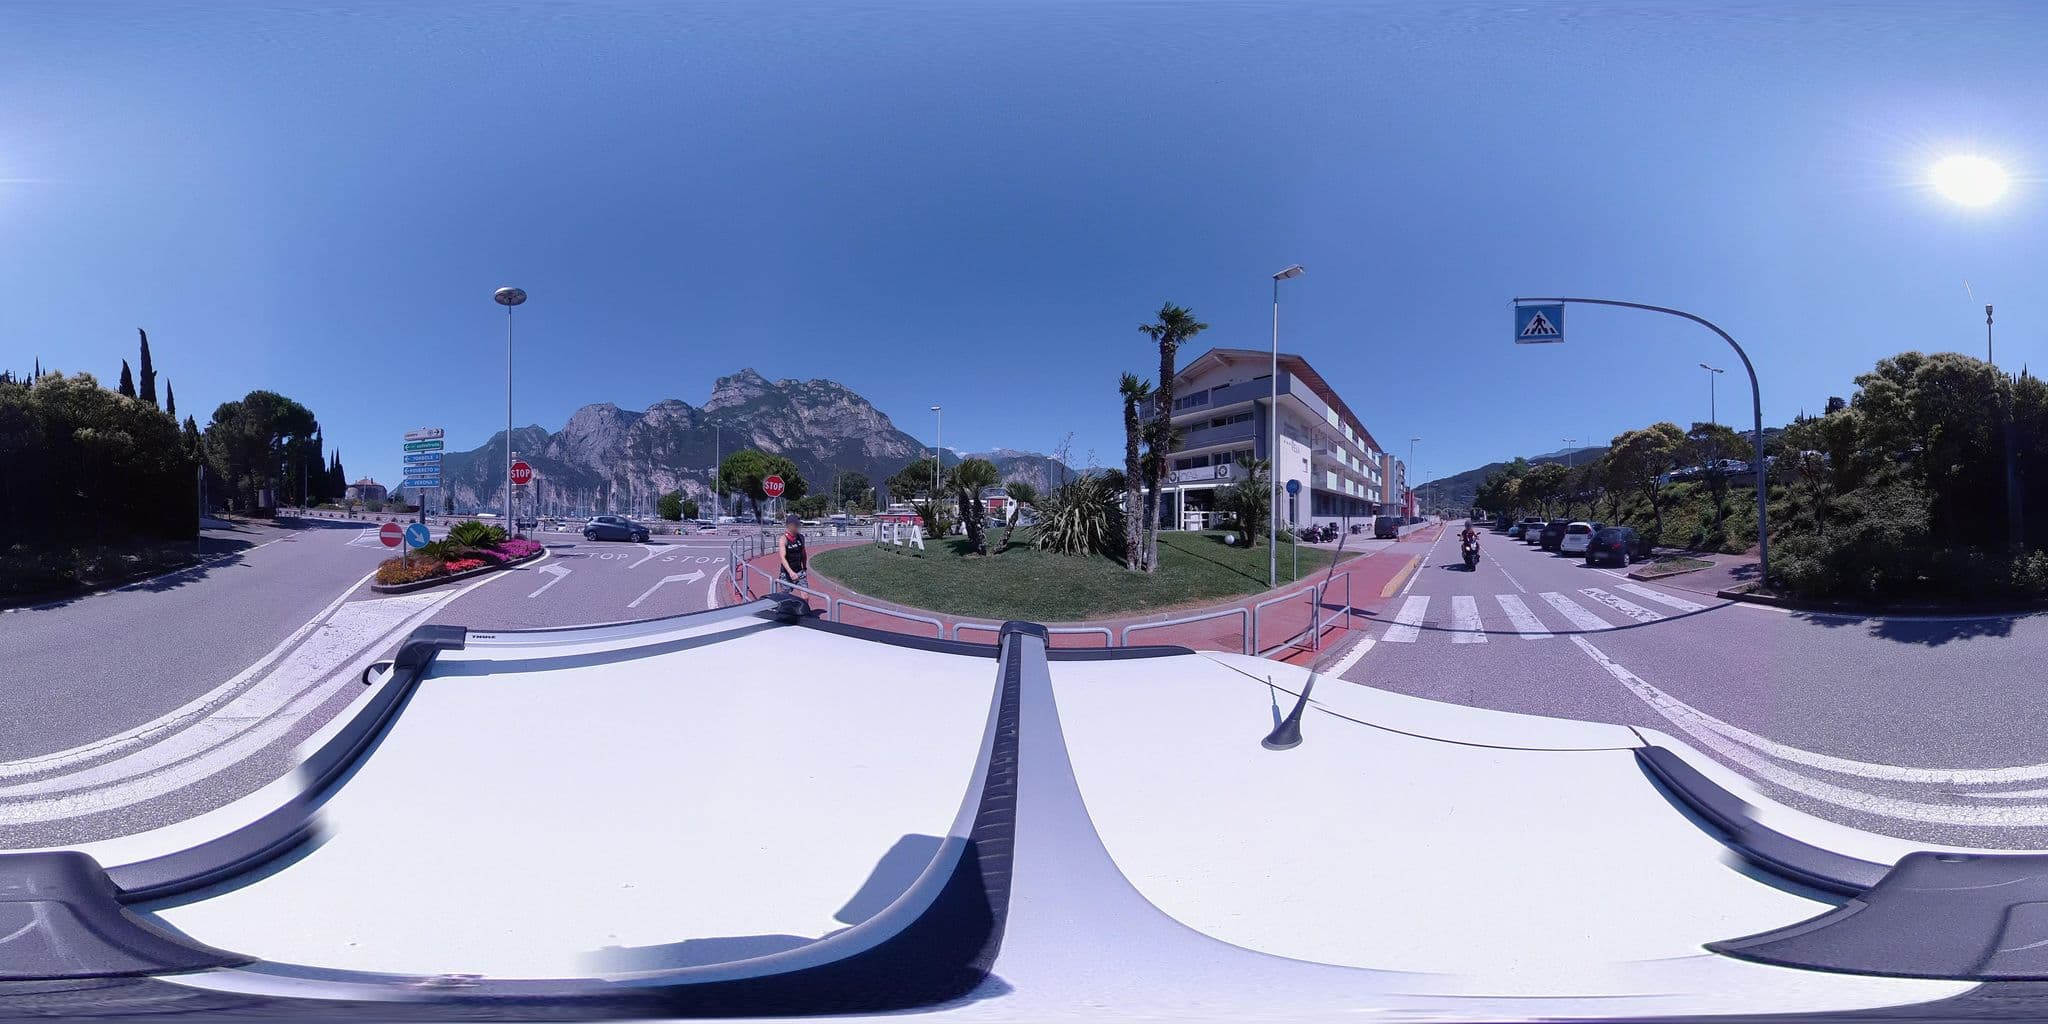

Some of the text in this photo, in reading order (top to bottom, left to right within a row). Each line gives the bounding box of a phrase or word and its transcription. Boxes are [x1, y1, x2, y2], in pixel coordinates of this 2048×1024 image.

[511, 469, 530, 478] STOP
[765, 481, 783, 490] STOP
[662, 555, 726, 564] STOP
